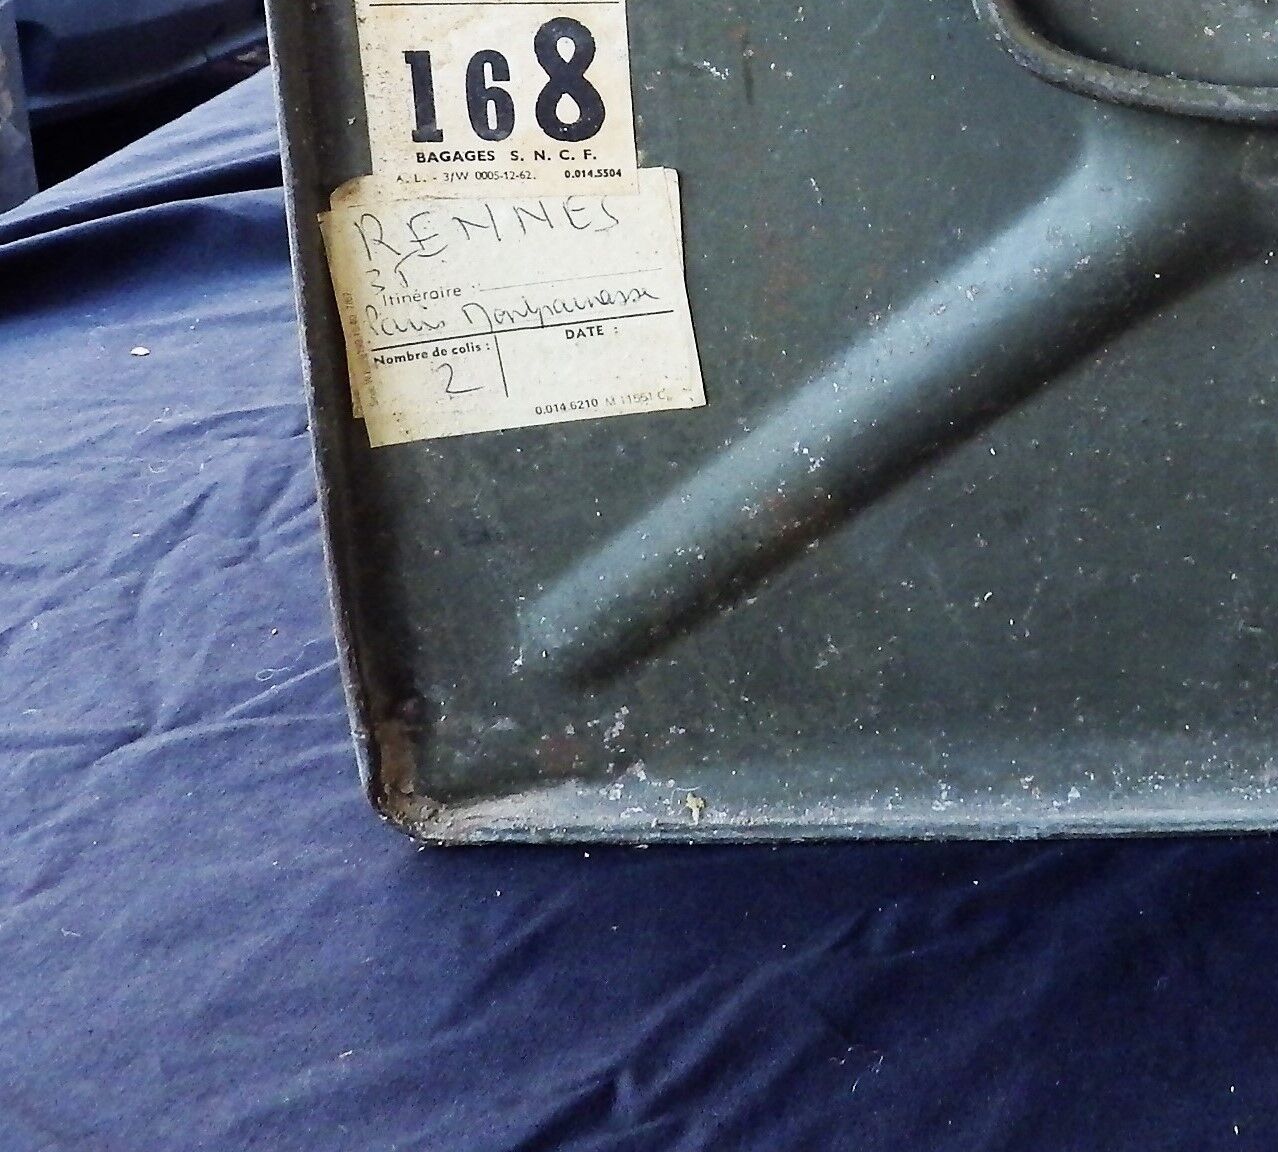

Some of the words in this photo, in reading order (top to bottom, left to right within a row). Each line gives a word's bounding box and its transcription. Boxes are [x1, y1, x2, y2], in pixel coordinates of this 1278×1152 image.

[402, 16, 606, 143] 168
[416, 150, 496, 164] BAGAGES
[510, 150, 525, 162] S.
[533, 149, 551, 161] N.
[559, 149, 575, 161] C.
[583, 149, 597, 160] F.
[564, 168, 622, 180] 0.014.5504
[353, 194, 620, 261] RENNES
[382, 285, 462, 307] Itinéraire
[564, 325, 605, 340] DATE
[373, 349, 429, 366] Nombre
[432, 346, 448, 358] de
[451, 342, 482, 356] colis
[437, 362, 484, 395] 2
